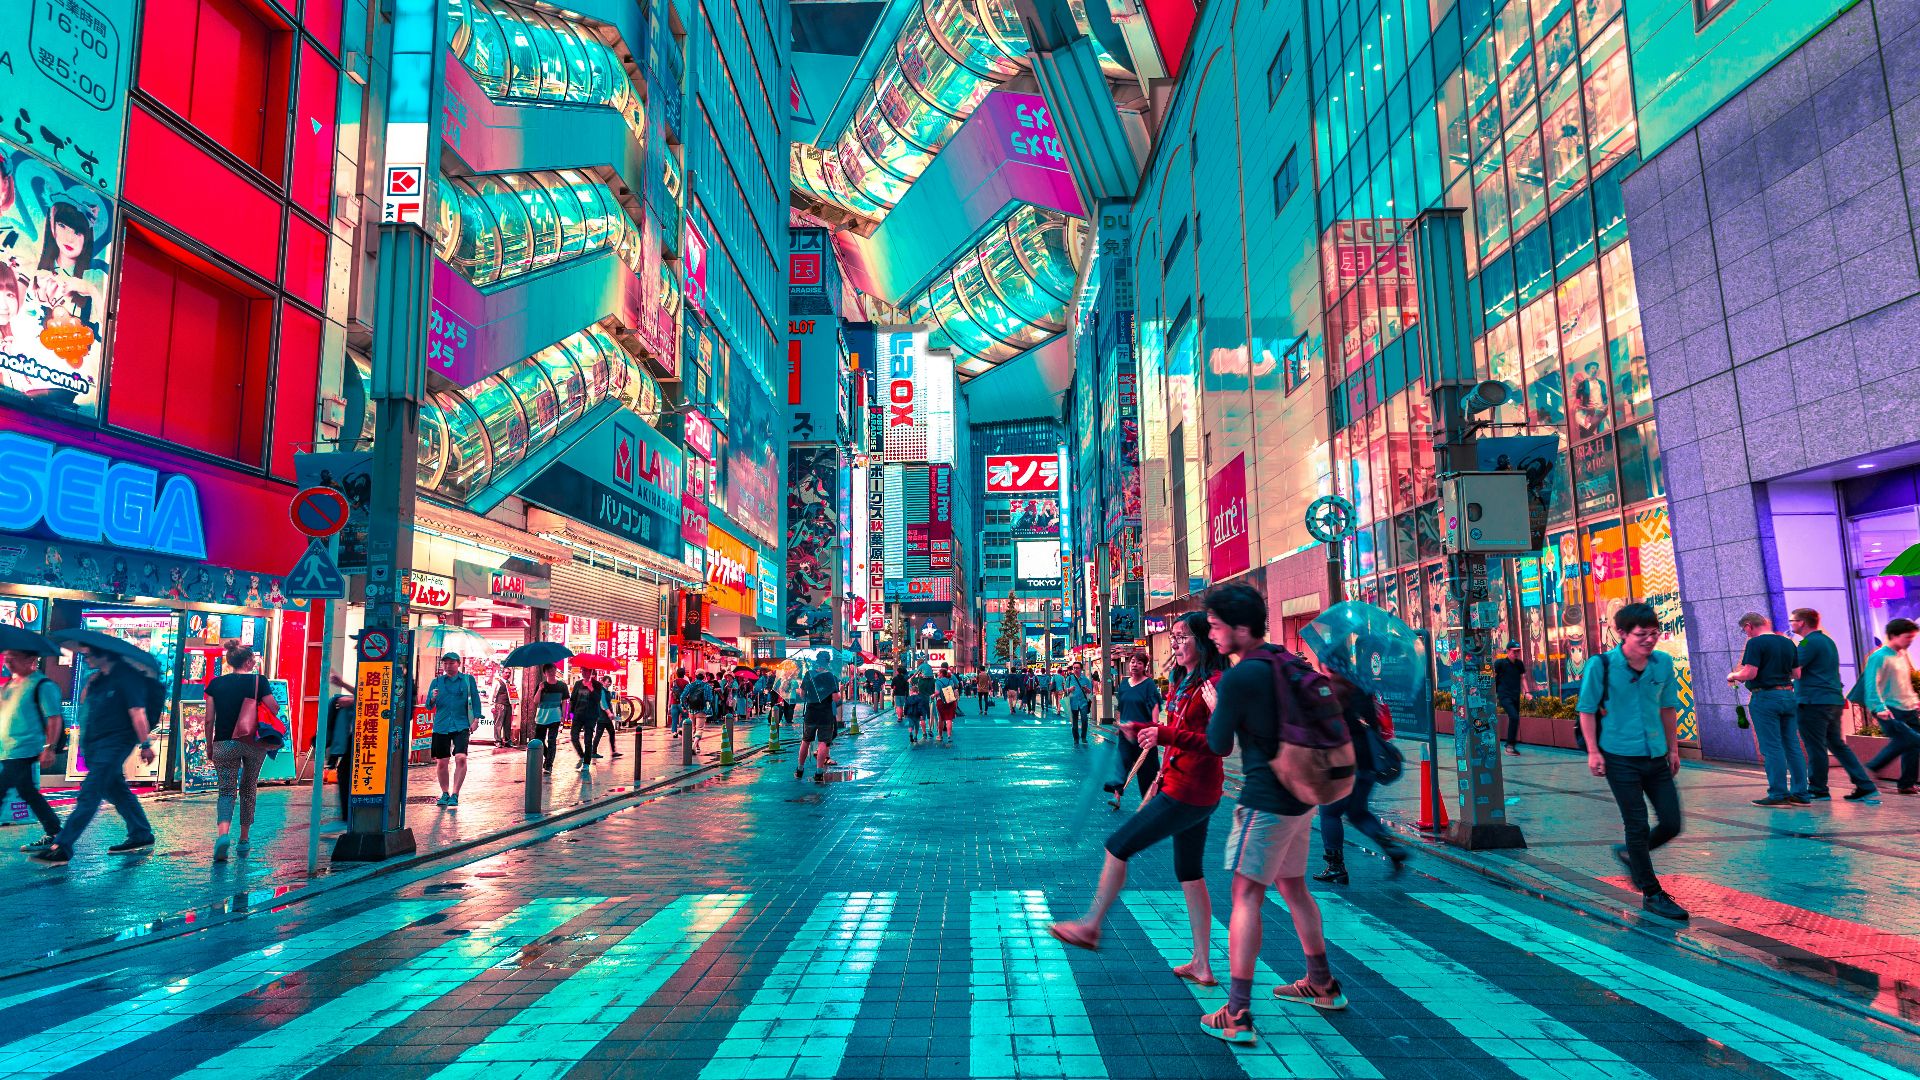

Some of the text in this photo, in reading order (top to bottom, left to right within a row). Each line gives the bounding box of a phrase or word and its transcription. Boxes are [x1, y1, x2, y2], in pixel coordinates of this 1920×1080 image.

[47, 2, 107, 59] 16:00
[431, 310, 467, 348] カメラ
[429, 340, 455, 368] メラ
[638, 439, 680, 500] LABI
[0, 431, 207, 560] SEGA
[599, 494, 651, 541] パソコン館
[638, 484, 680, 519] AKIHABARA
[936, 467, 950, 521] Duty Free
[503, 575, 525, 592] LABI
[361, 671, 381, 790] 路上喫煙禁止です。
[416, 713, 434, 724] au
